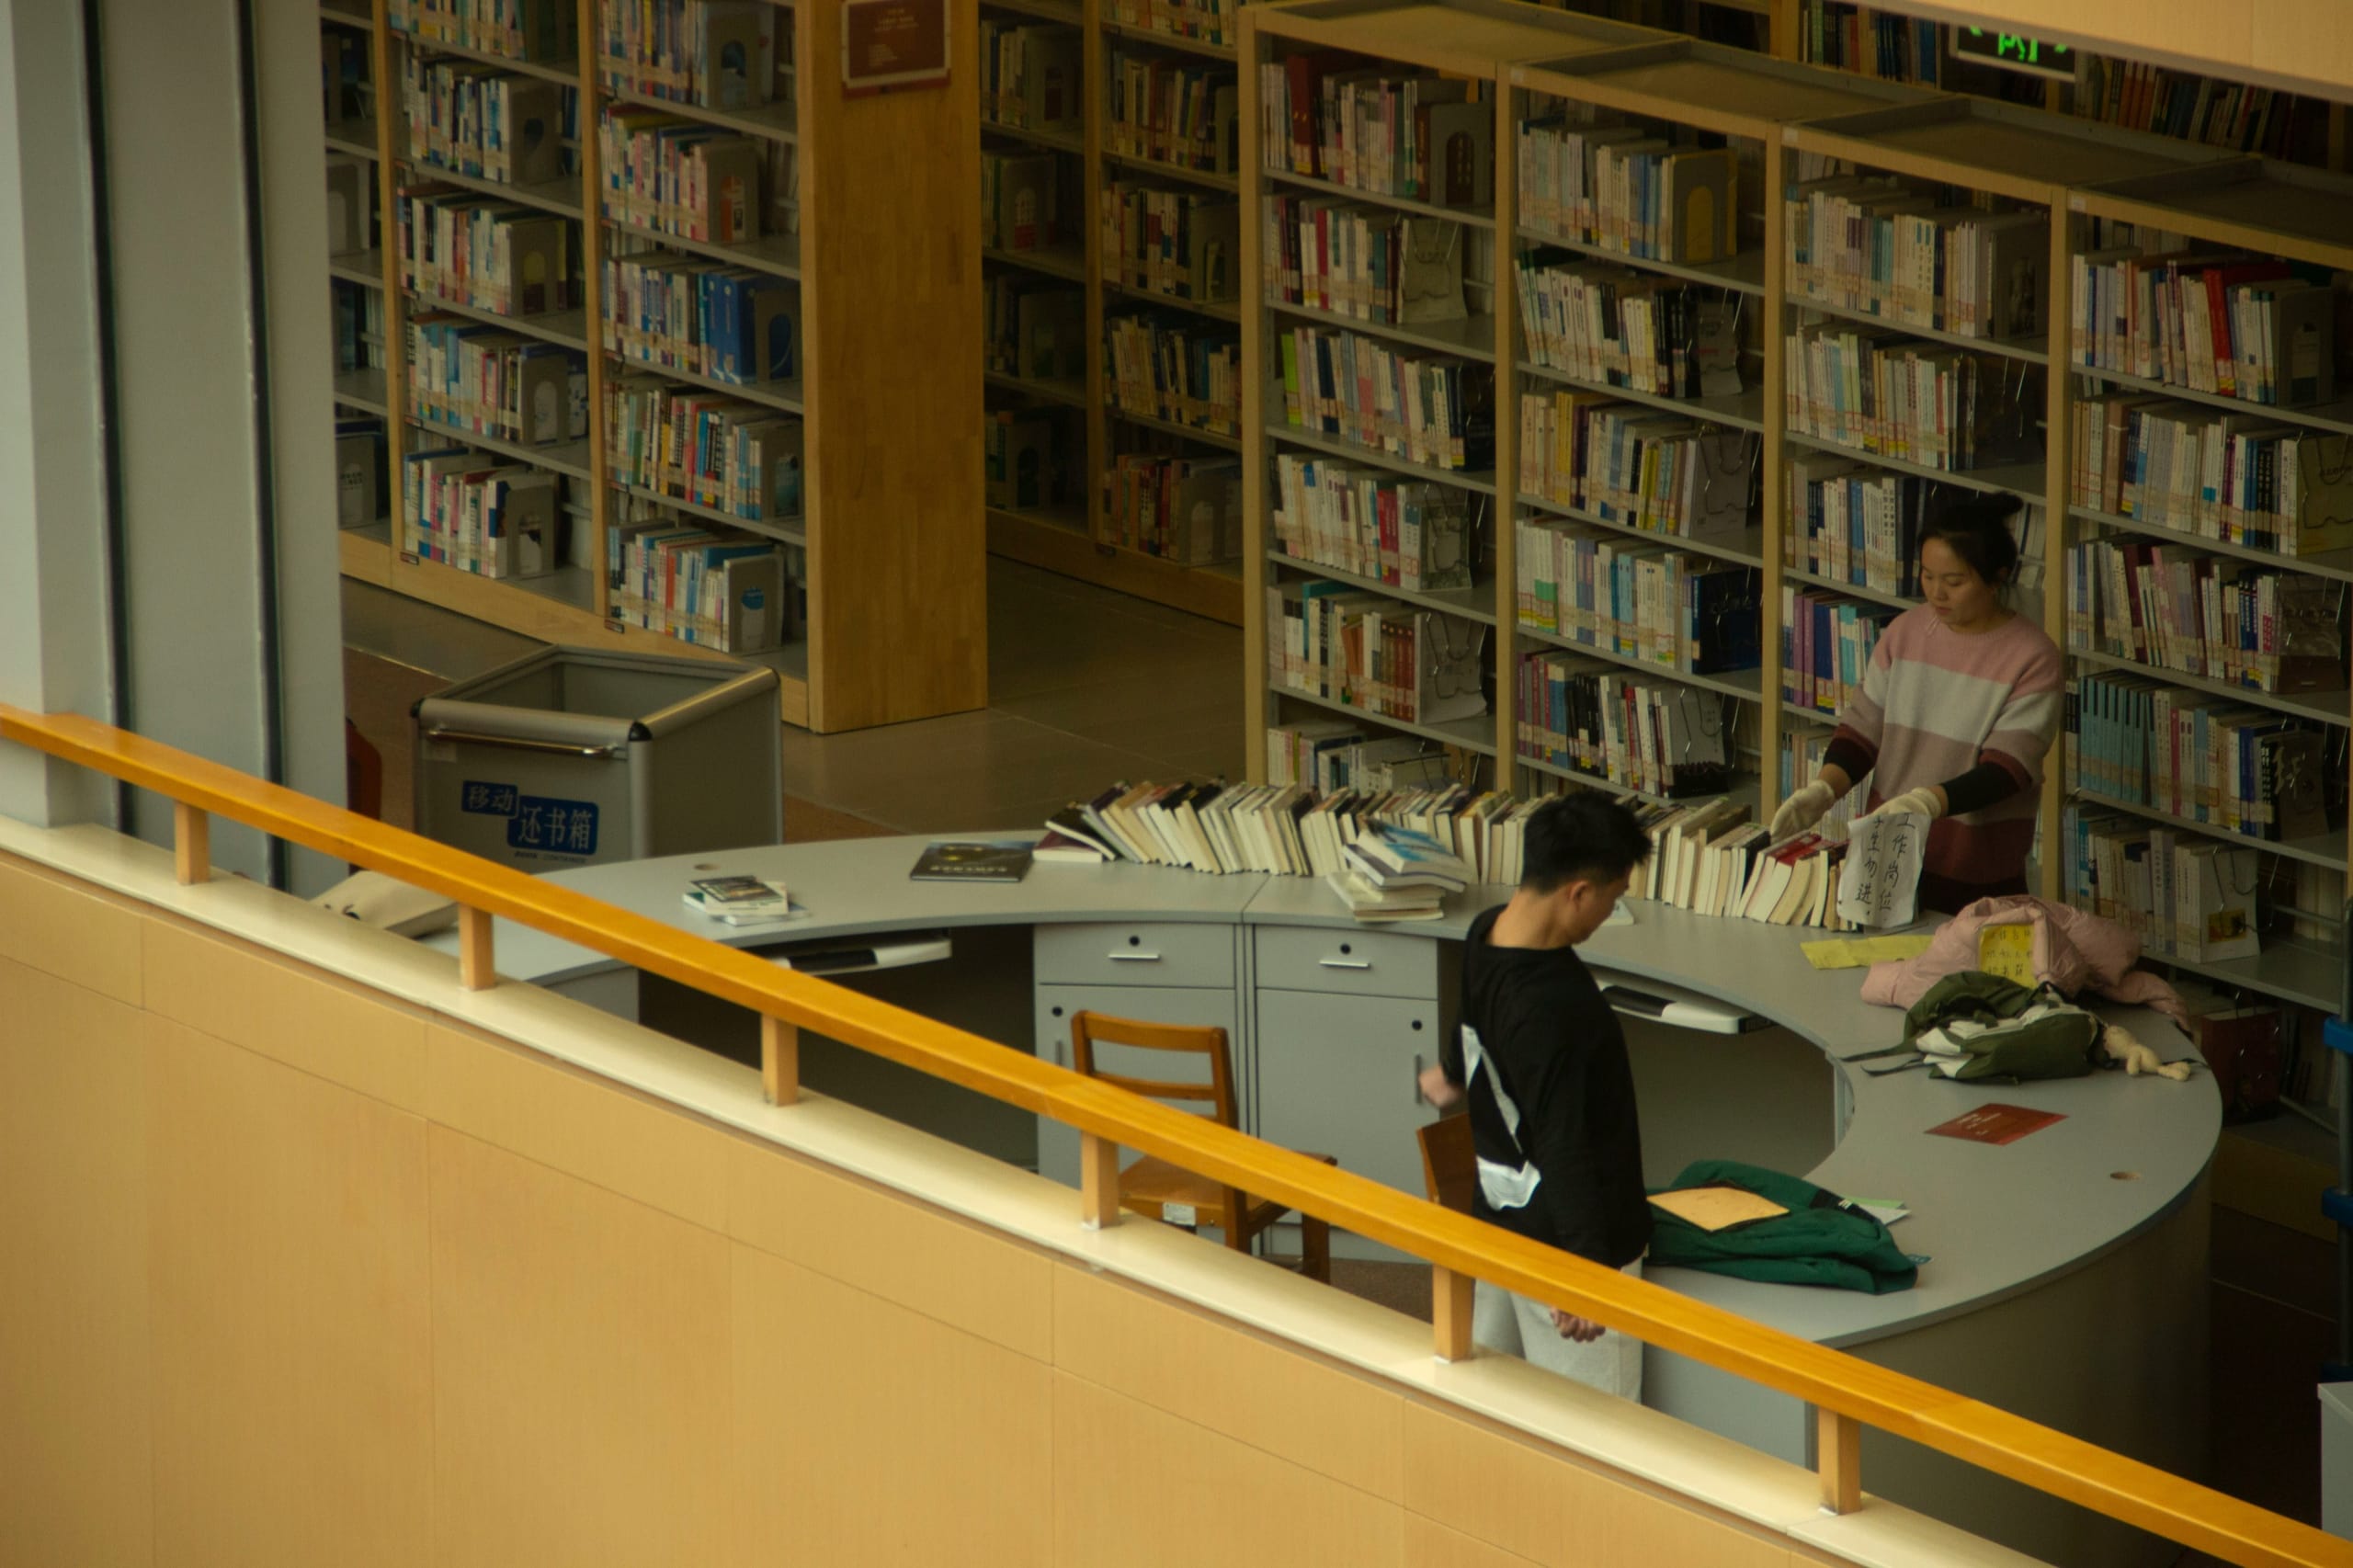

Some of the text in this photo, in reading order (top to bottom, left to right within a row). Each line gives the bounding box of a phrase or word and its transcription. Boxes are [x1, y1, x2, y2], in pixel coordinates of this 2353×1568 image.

[468, 786, 514, 812] 移动
[517, 804, 593, 850] 还书箱
[1879, 812, 1916, 911] 工作岗位
